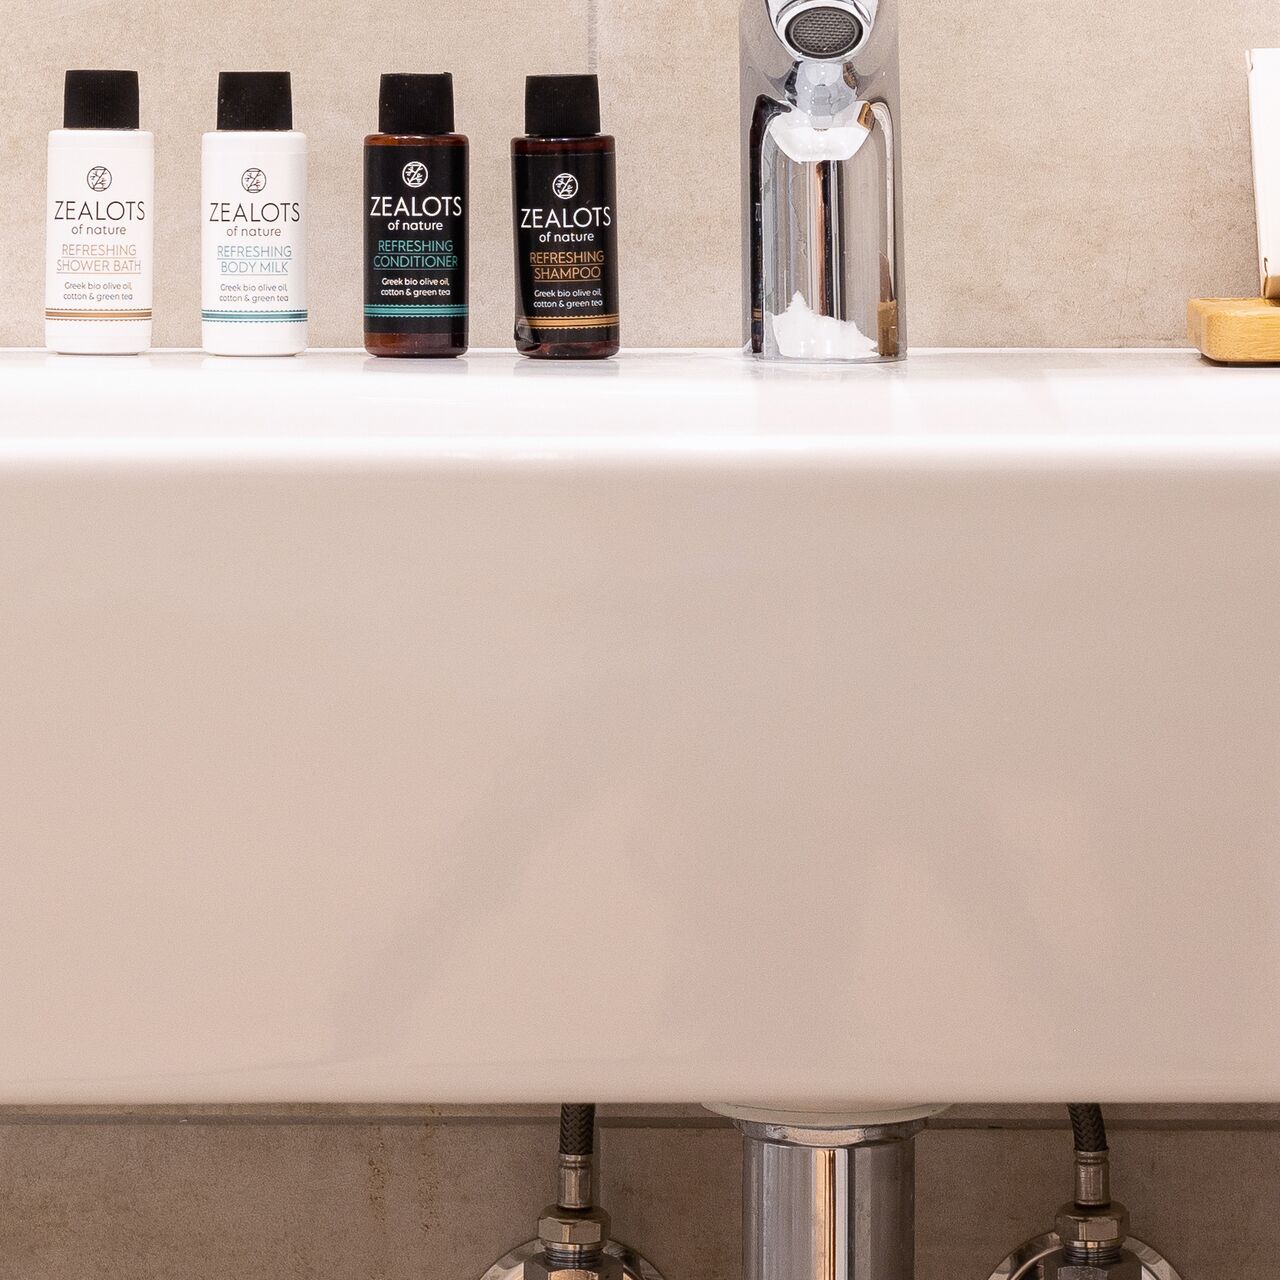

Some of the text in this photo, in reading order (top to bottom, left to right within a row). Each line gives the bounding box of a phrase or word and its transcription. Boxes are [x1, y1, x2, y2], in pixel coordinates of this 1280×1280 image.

[54, 200, 146, 221] ZEALOTS
[209, 202, 301, 223] ZEALOTS
[369, 196, 462, 217] ZEALOTS
[521, 206, 611, 229] ZEALOTS
[71, 224, 127, 235] of nature
[226, 226, 282, 237] of nature
[387, 220, 444, 231] of nature
[539, 231, 594, 243] of nature
[62, 243, 136, 256] REFRESHING
[217, 245, 292, 258] REFRESHING
[378, 239, 453, 252] REFRESHING
[373, 255, 458, 268] CONDITIONER
[530, 251, 605, 264] REFRESHING
[56, 259, 141, 272] SHOWER BATH
[221, 261, 289, 273] BODY MILK
[534, 266, 601, 279] SHAMPOO
[64, 281, 86, 290] Greek
[88, 281, 101, 290] bio
[102, 281, 121, 290] olive
[220, 283, 241, 292] Greek
[243, 283, 256, 292] bio
[257, 283, 277, 292] olive
[381, 277, 403, 286] Greek
[404, 277, 418, 286] bio
[419, 277, 438, 286] olive
[97, 293, 120, 302] green
[380, 288, 451, 298] cotton & green tea
[534, 289, 556, 297] Greek
[557, 289, 571, 297] bio
[572, 288, 591, 297] olive
[219, 294, 289, 304] cotton & green tea
[533, 299, 603, 310] cotton & green tea
